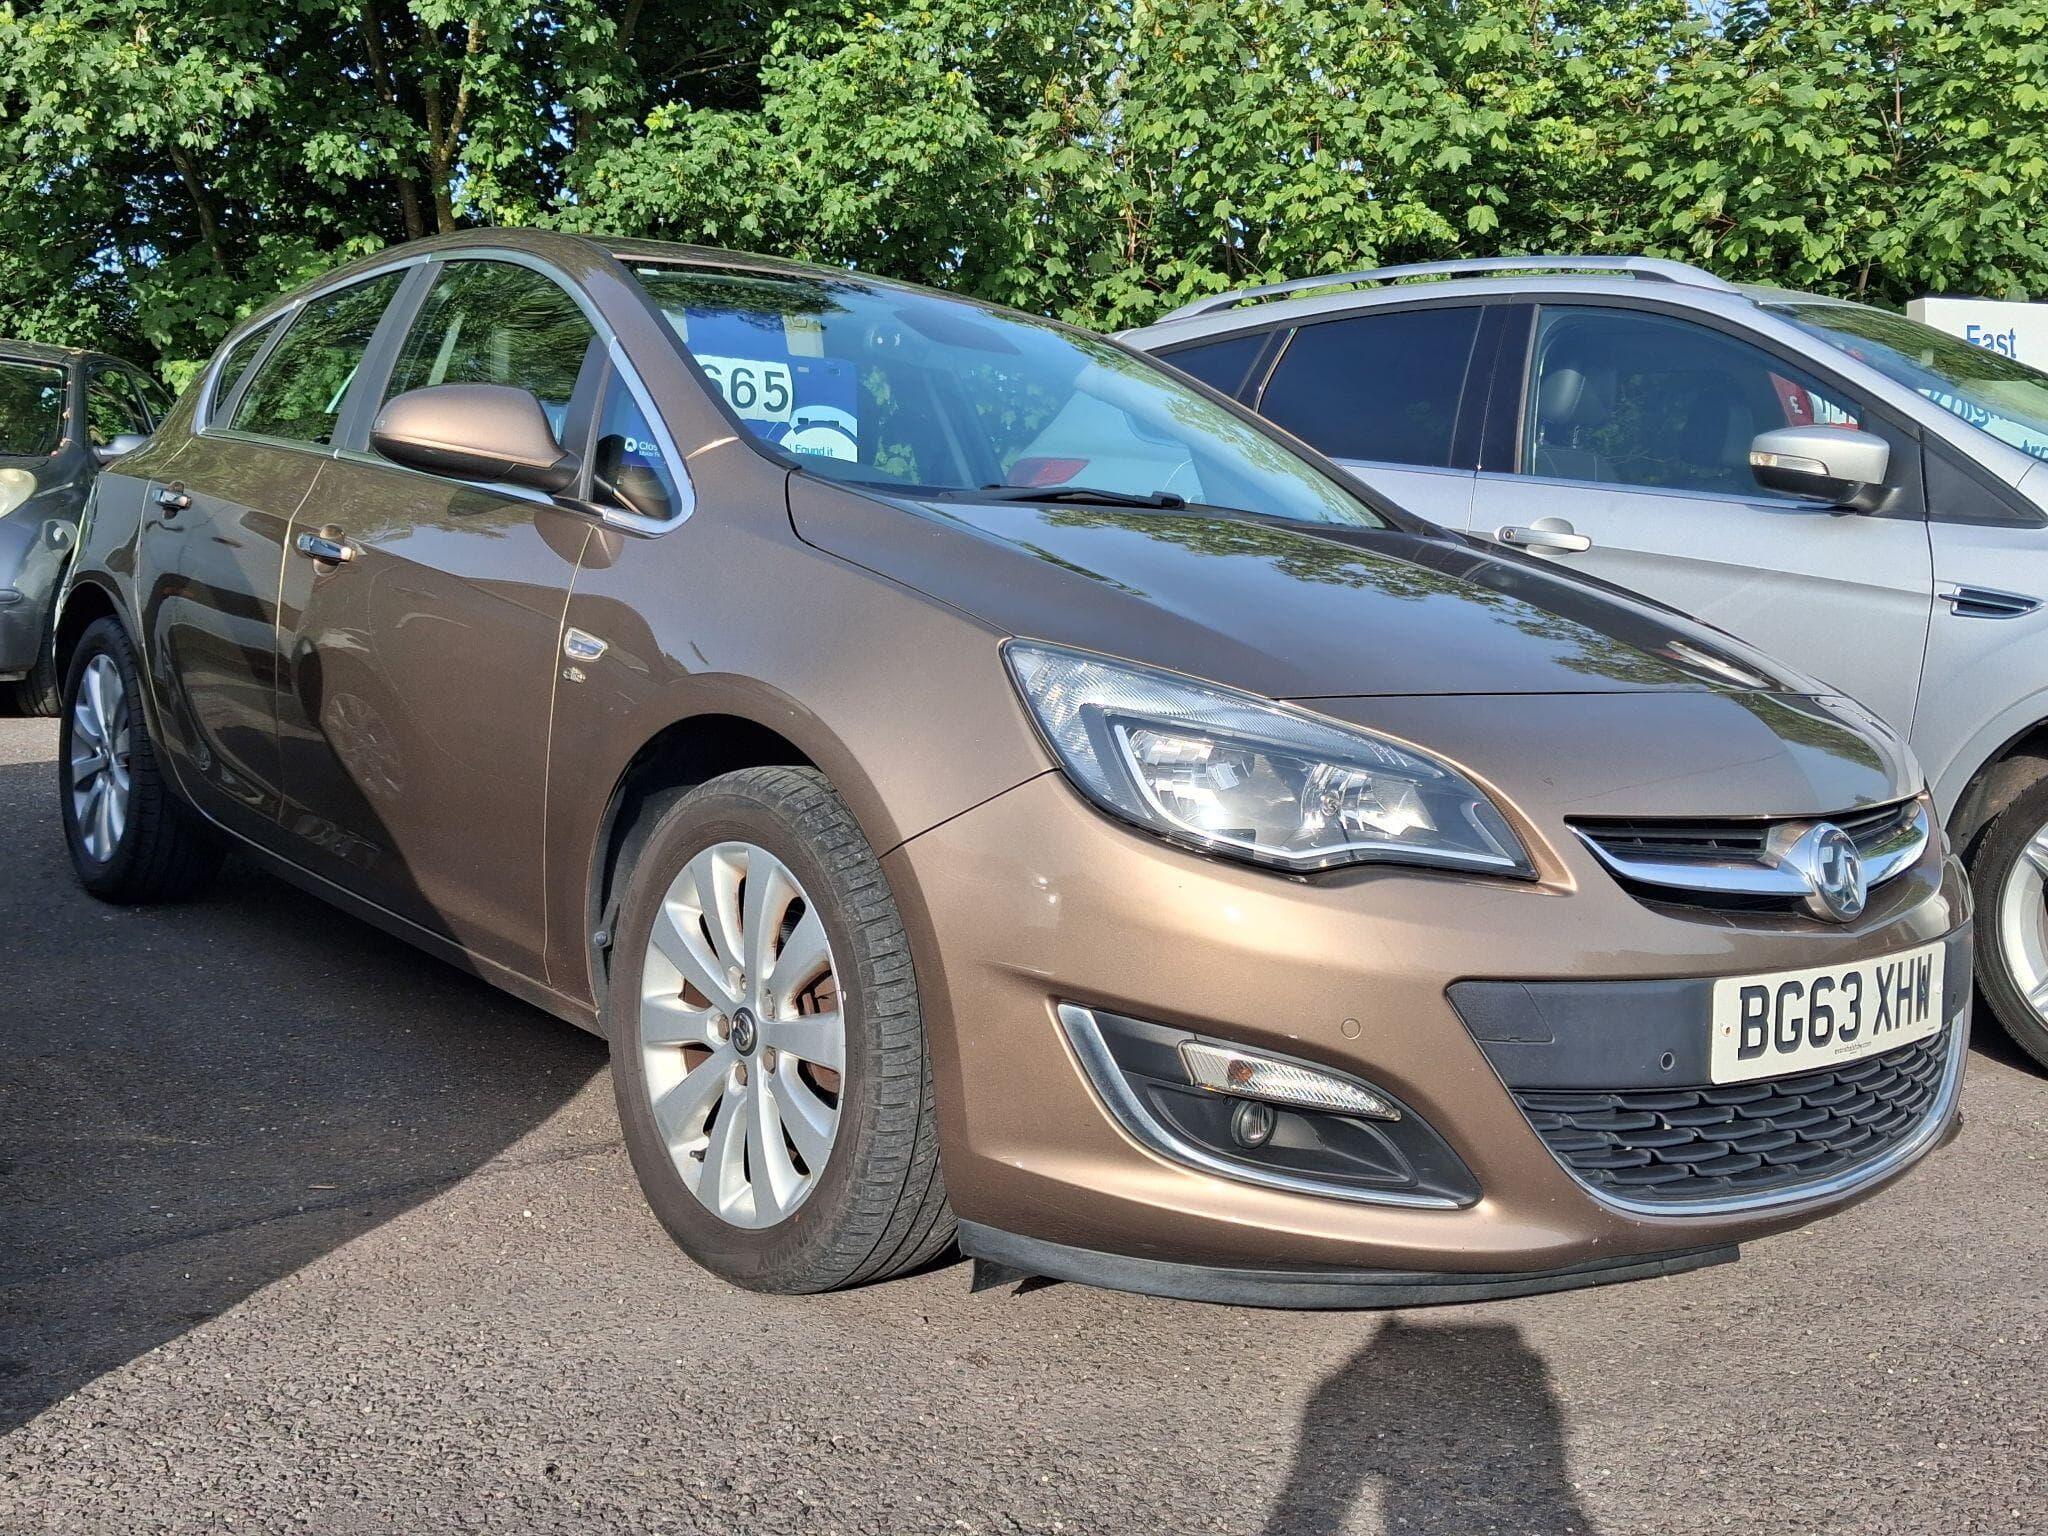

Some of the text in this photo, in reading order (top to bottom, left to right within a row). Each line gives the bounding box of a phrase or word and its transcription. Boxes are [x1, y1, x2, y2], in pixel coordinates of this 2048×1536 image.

[1966, 325, 2017, 358] East
[795, 444, 825, 456] Found
[827, 446, 834, 456] it
[1737, 953, 1933, 1061] BG63 XHW
